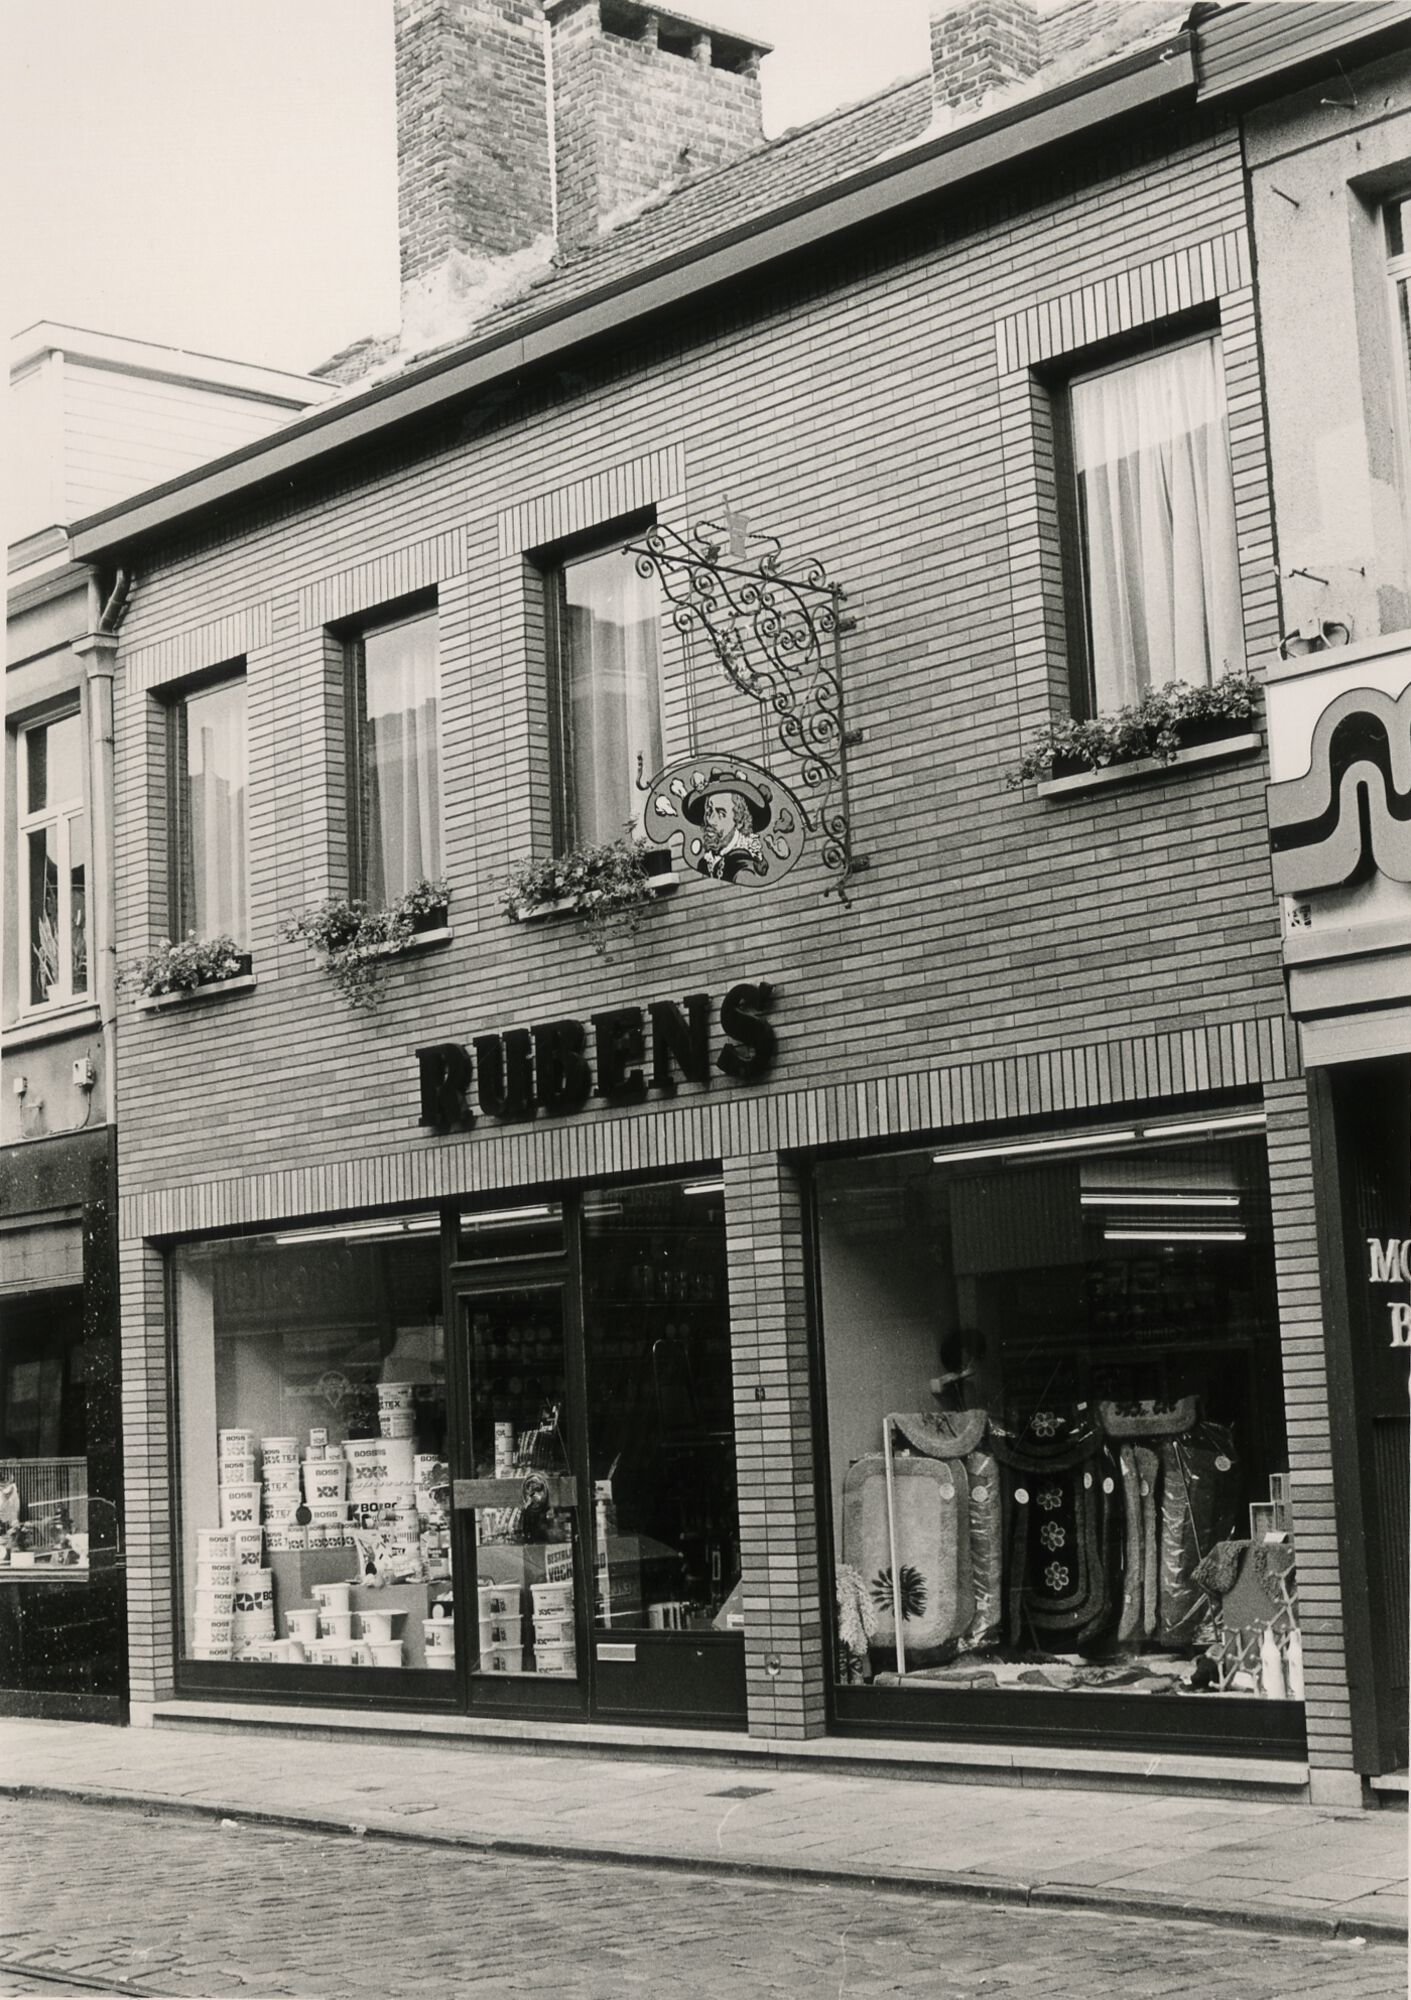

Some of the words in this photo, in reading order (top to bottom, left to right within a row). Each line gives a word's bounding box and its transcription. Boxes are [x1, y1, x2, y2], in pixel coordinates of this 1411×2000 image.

[416, 982, 776, 1130] RUBENS
[228, 1492, 253, 1500] BOSS
[314, 1510, 338, 1518] BOSS
